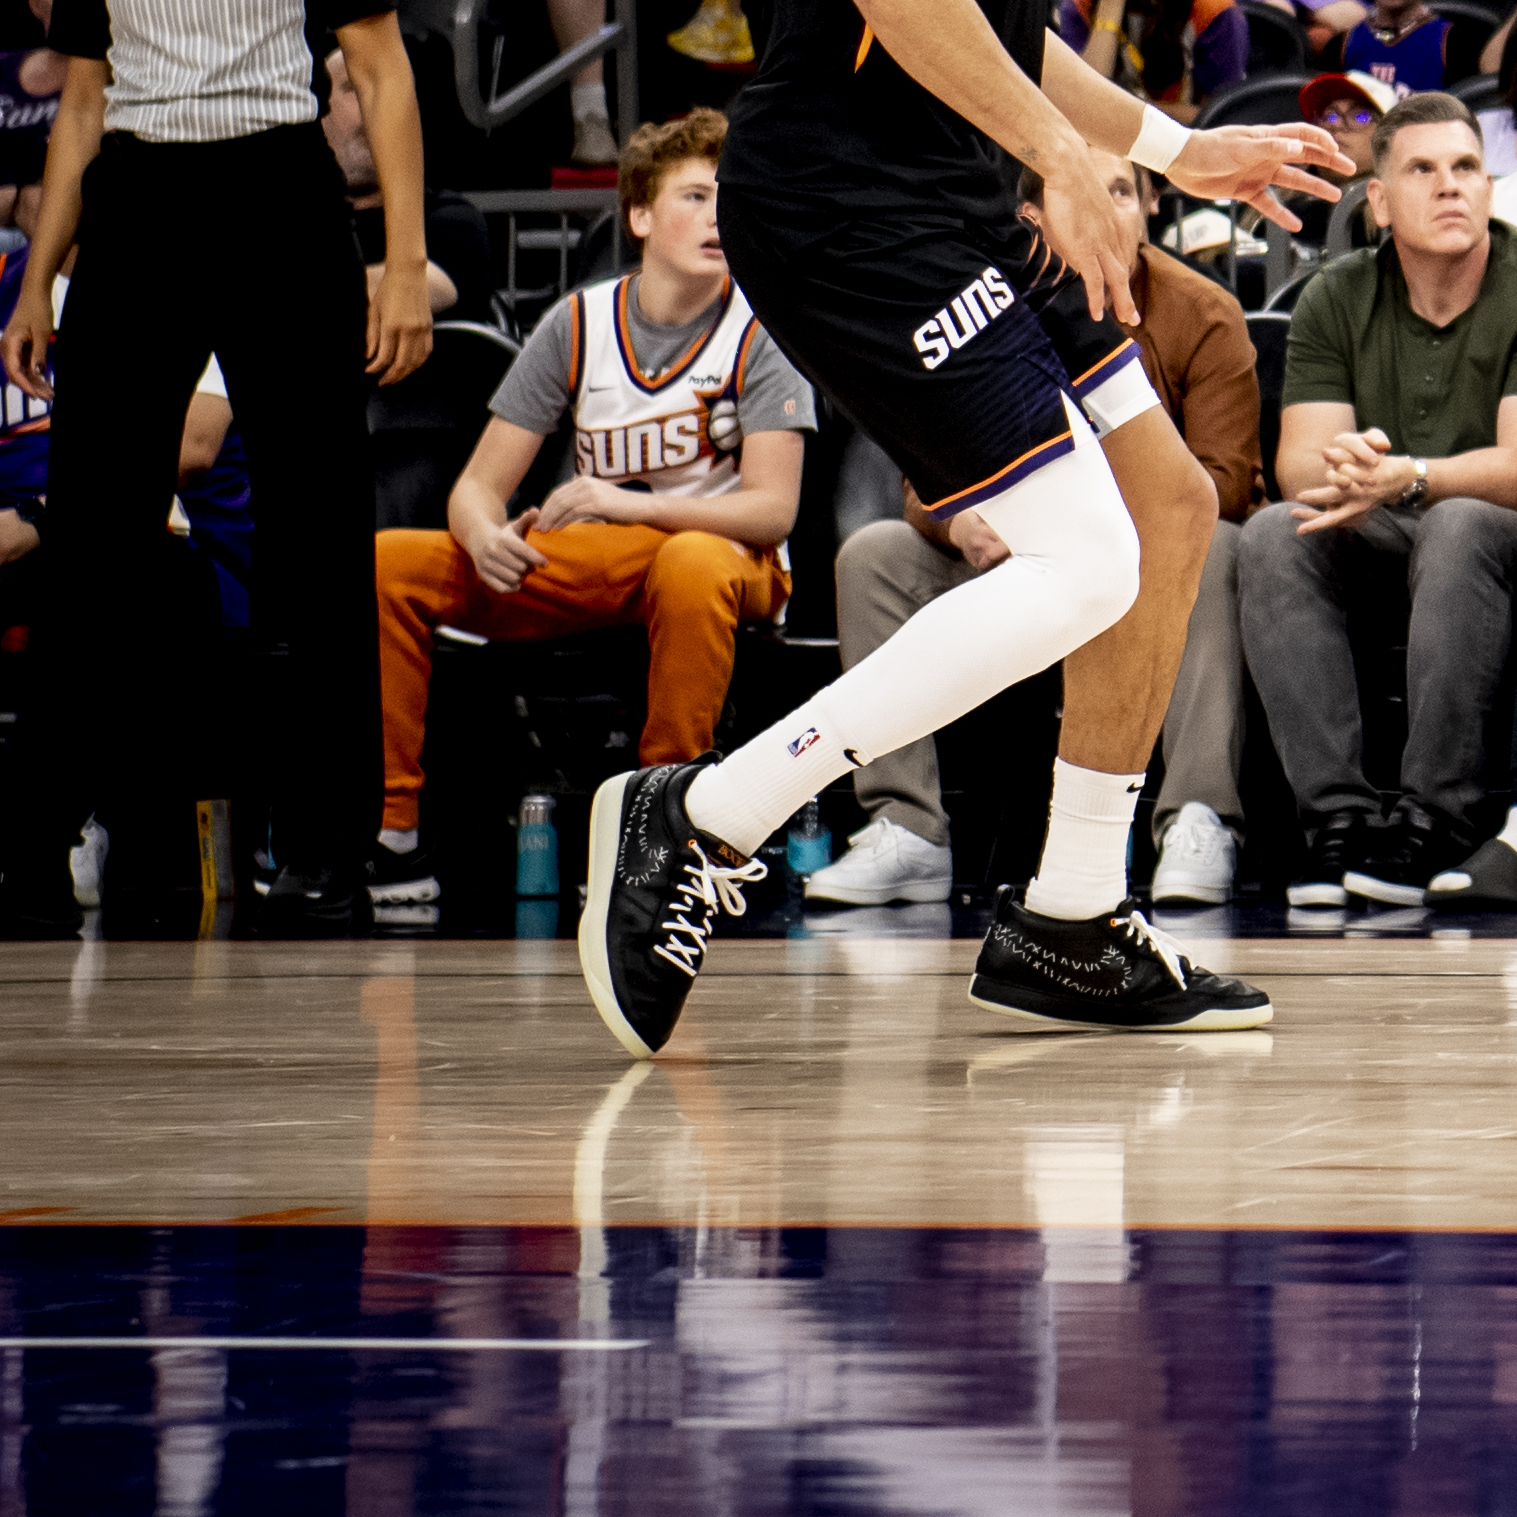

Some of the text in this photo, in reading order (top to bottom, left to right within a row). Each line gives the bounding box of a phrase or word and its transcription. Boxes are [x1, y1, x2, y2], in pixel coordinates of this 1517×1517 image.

[910, 266, 1015, 371] SUNS
[688, 375, 721, 388] PayPal
[577, 417, 705, 478] SUNS
